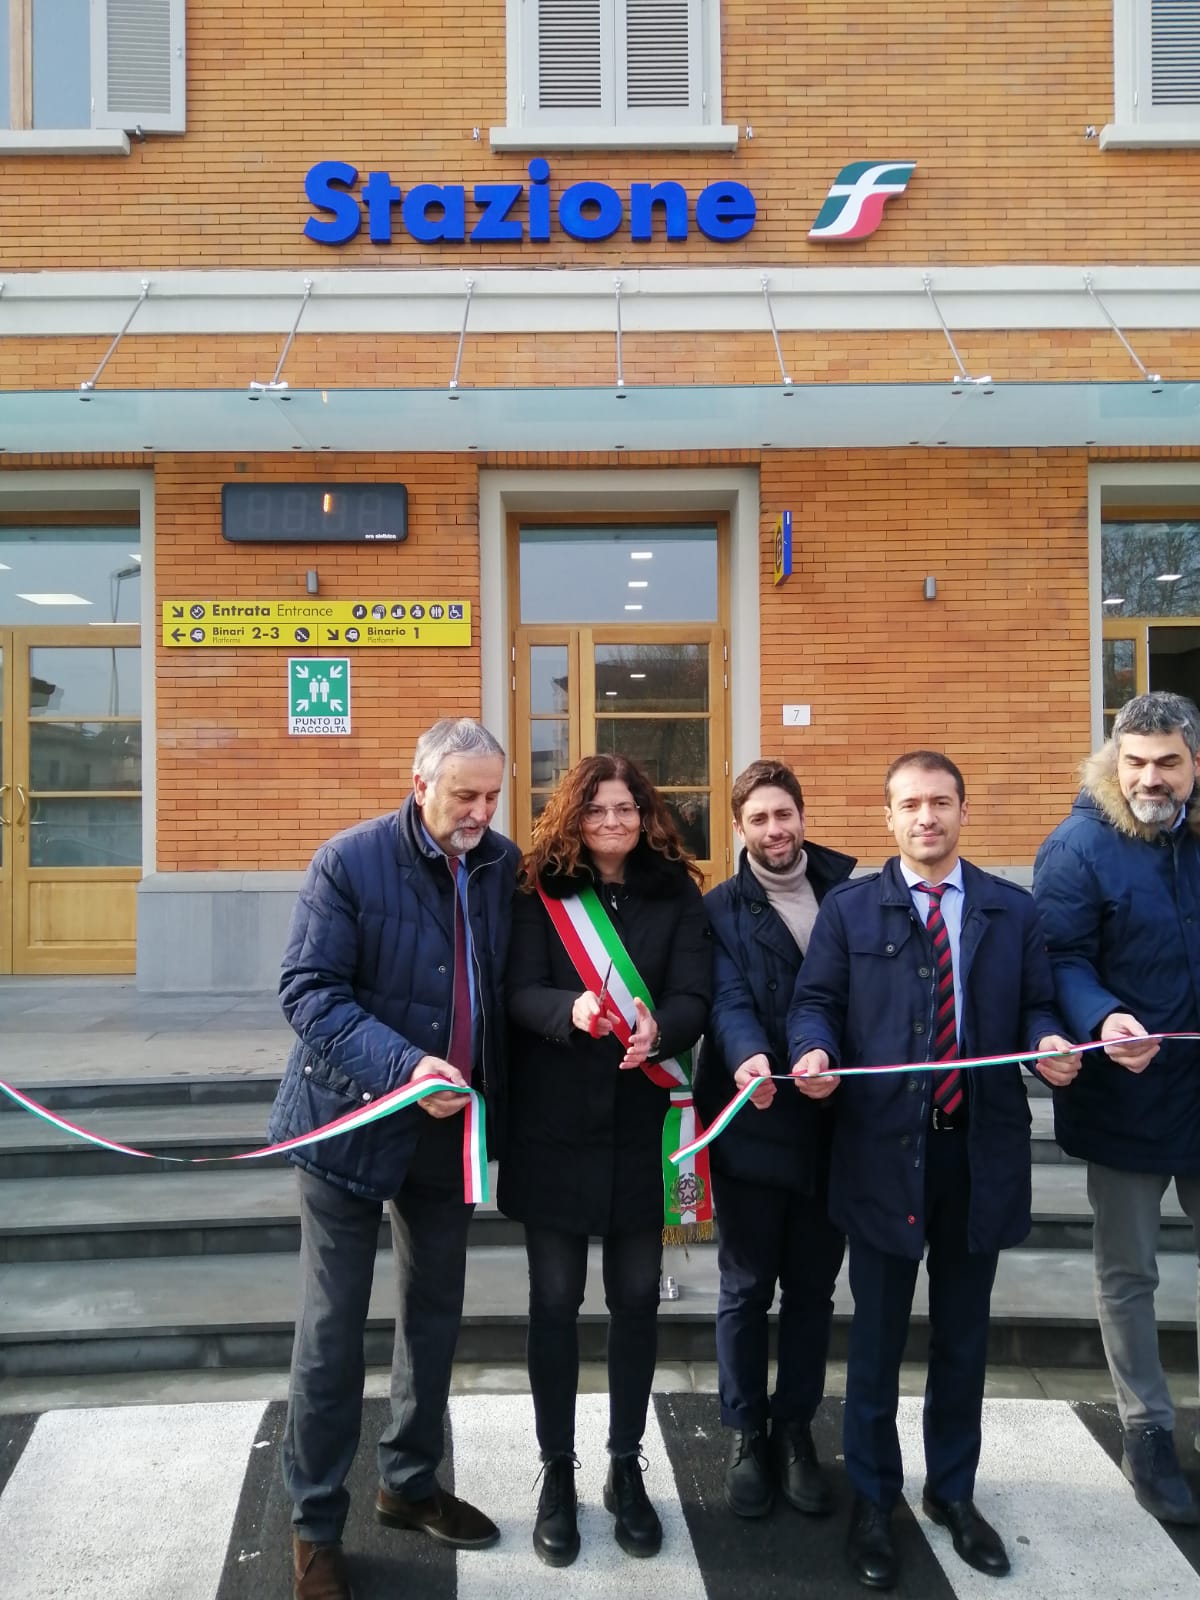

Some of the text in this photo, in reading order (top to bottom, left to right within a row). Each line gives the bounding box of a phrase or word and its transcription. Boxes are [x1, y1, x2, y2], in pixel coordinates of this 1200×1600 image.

[303, 158, 757, 245] Stazione
[212, 604, 334, 617] Entrata Entrance
[212, 627, 280, 640] Binari 2-3
[367, 627, 420, 639] Binario 1
[295, 717, 344, 725] PUNTO DI
[793, 709, 800, 721] 7
[292, 726, 347, 734] RACCOLTA
